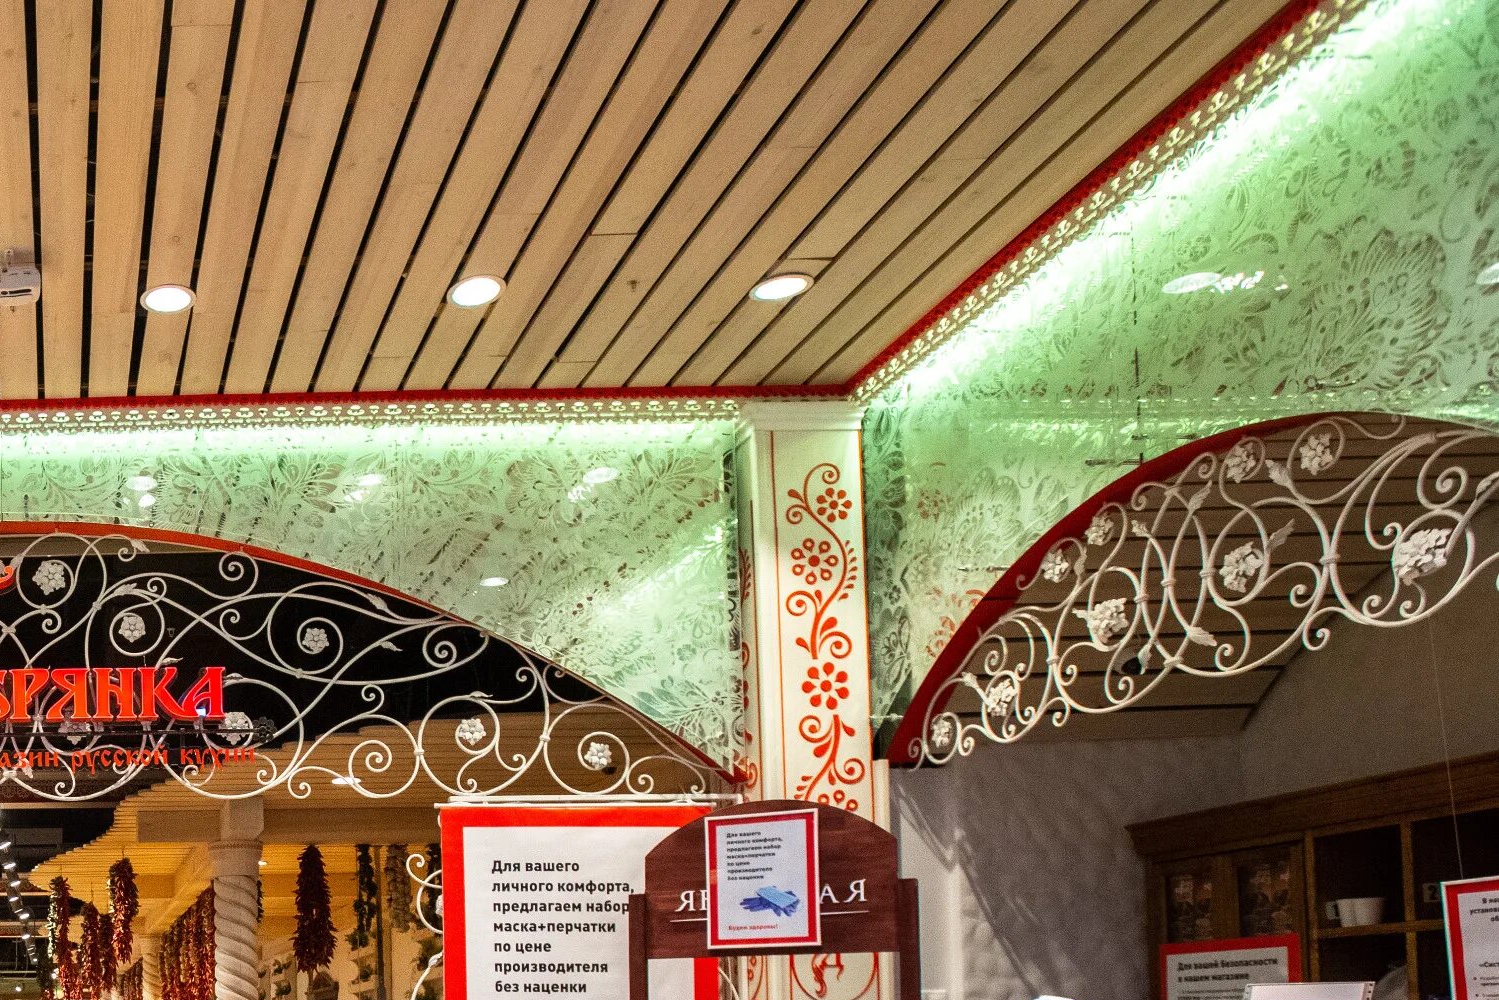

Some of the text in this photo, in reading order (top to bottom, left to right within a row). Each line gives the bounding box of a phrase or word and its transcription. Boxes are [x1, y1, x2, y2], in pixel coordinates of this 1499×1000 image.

[72, 748, 169, 773] русской
[491, 860, 580, 876] Для вашего
[492, 878, 635, 896] личного комфорта,
[493, 900, 582, 916] предлагаем
[494, 920, 616, 936] маска+перчатки
[494, 941, 552, 955] по цене
[495, 960, 609, 976] производителя
[495, 978, 587, 996] без наценки
